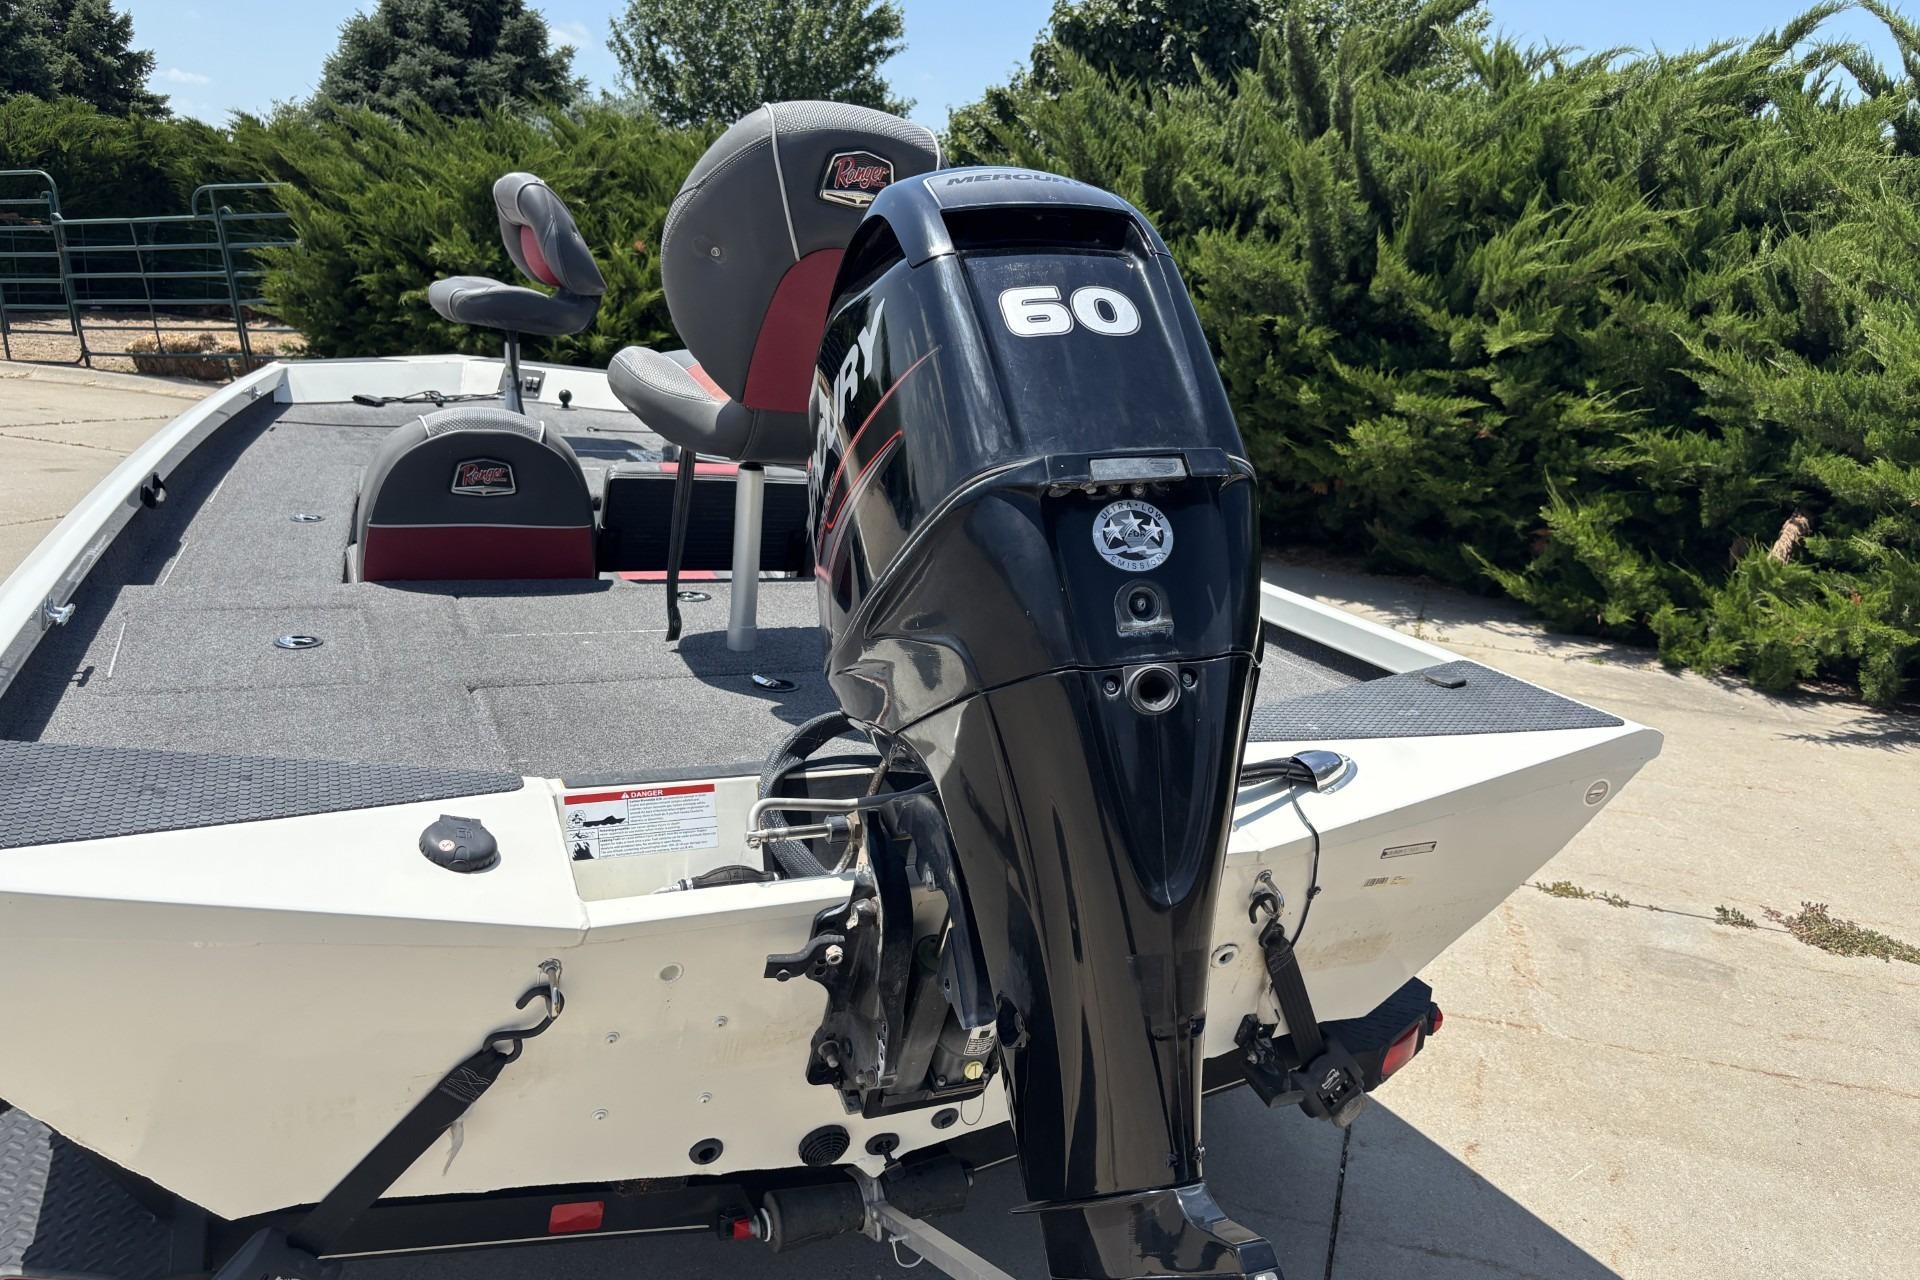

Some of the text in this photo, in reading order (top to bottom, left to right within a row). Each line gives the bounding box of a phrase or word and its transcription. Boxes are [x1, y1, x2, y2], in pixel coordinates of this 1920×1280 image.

[834, 157, 889, 189] Ranger
[946, 173, 1081, 186] MERCUR
[998, 285, 1142, 337] 60
[460, 464, 508, 486] Ranger
[1101, 501, 1164, 521] ULTRA LOW
[630, 789, 664, 798] DANGER
